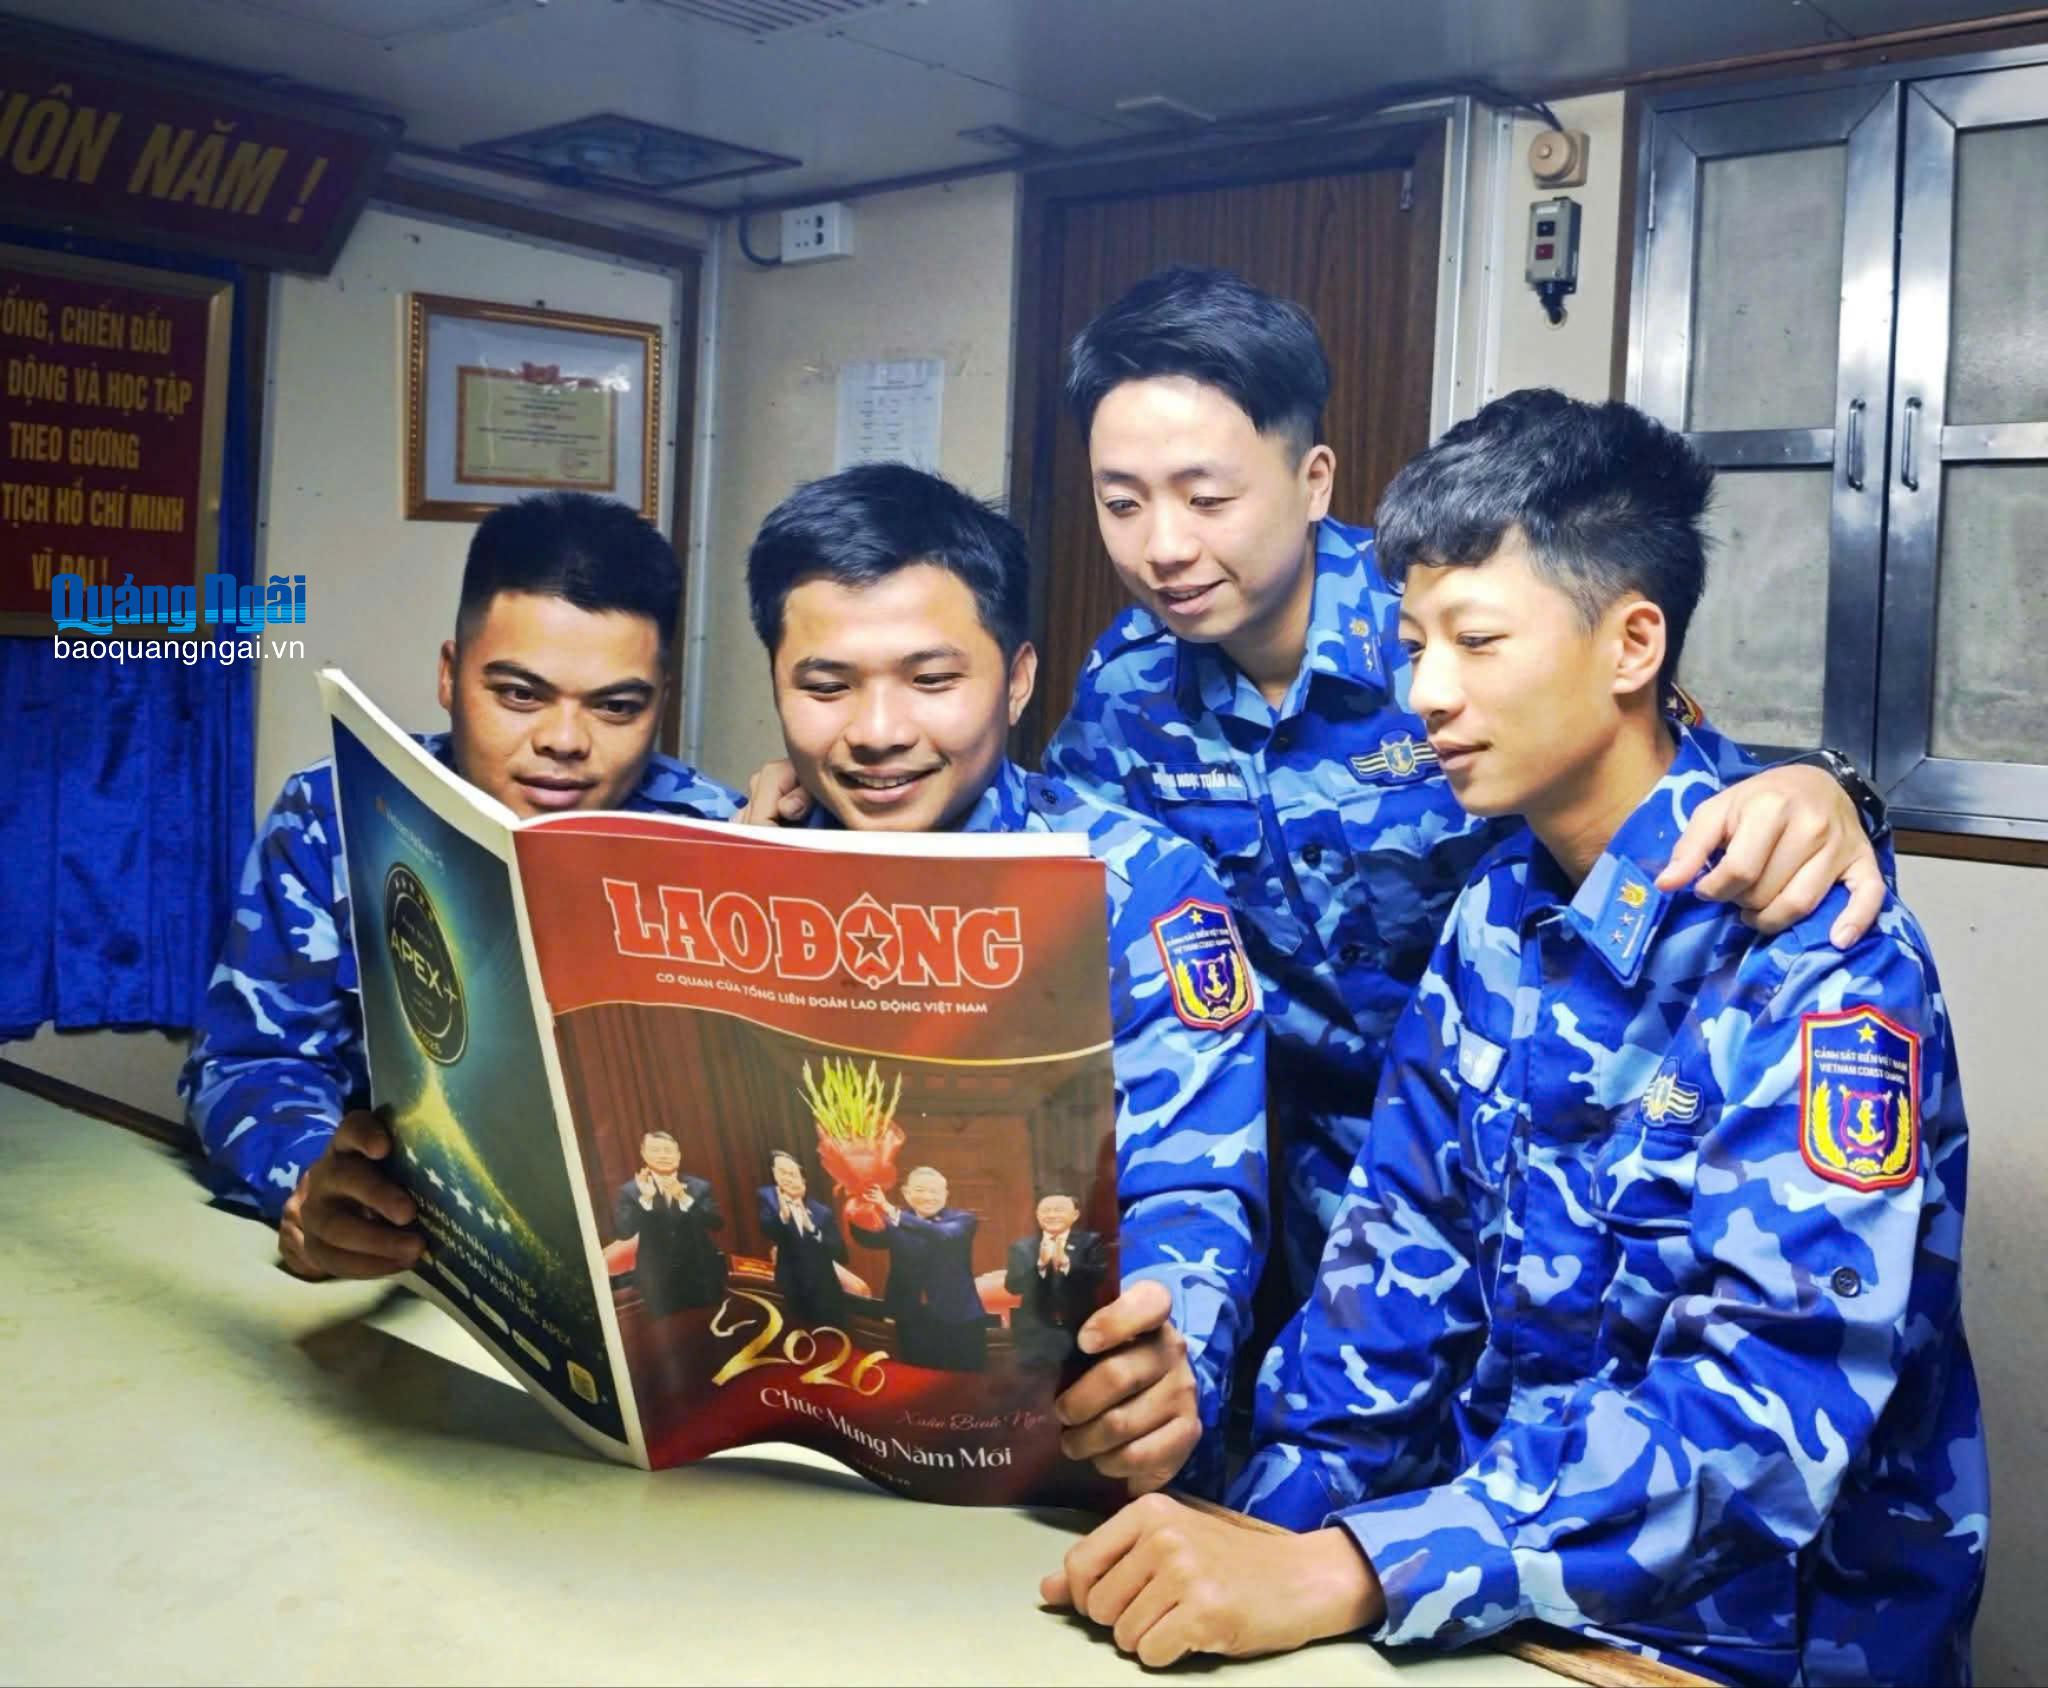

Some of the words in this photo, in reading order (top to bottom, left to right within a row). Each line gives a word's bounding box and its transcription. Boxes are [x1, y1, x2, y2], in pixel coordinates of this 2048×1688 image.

[127, 119, 289, 215] NĂM
[287, 156, 329, 223] !
[0, 284, 54, 344] ỐNG,
[61, 299, 126, 349] CHIẾN
[130, 304, 174, 354] ĐẤU
[8, 353, 67, 406] ĐỘNG
[74, 361, 101, 406] VÀ
[107, 369, 149, 416] HỌC
[153, 370, 193, 420] TẬP
[9, 420, 63, 463] THEO
[69, 425, 141, 469] GƯƠNG
[1, 482, 50, 528] TỊCH
[90, 485, 127, 529] CHÍ
[130, 493, 185, 533] MINH
[677, 974, 714, 989] QUAN
[778, 991, 806, 1006] LIÊN
[808, 996, 848, 1009] ĐOÀN
[850, 999, 878, 1010] LAO
[880, 998, 922, 1014] ĐỘNG
[923, 1001, 953, 1015] VIỆT
[956, 1003, 989, 1014] NAM
[709, 1288, 891, 1397] 2026
[891, 1437, 955, 1468] Năm
[959, 1446, 1012, 1468] Mới
